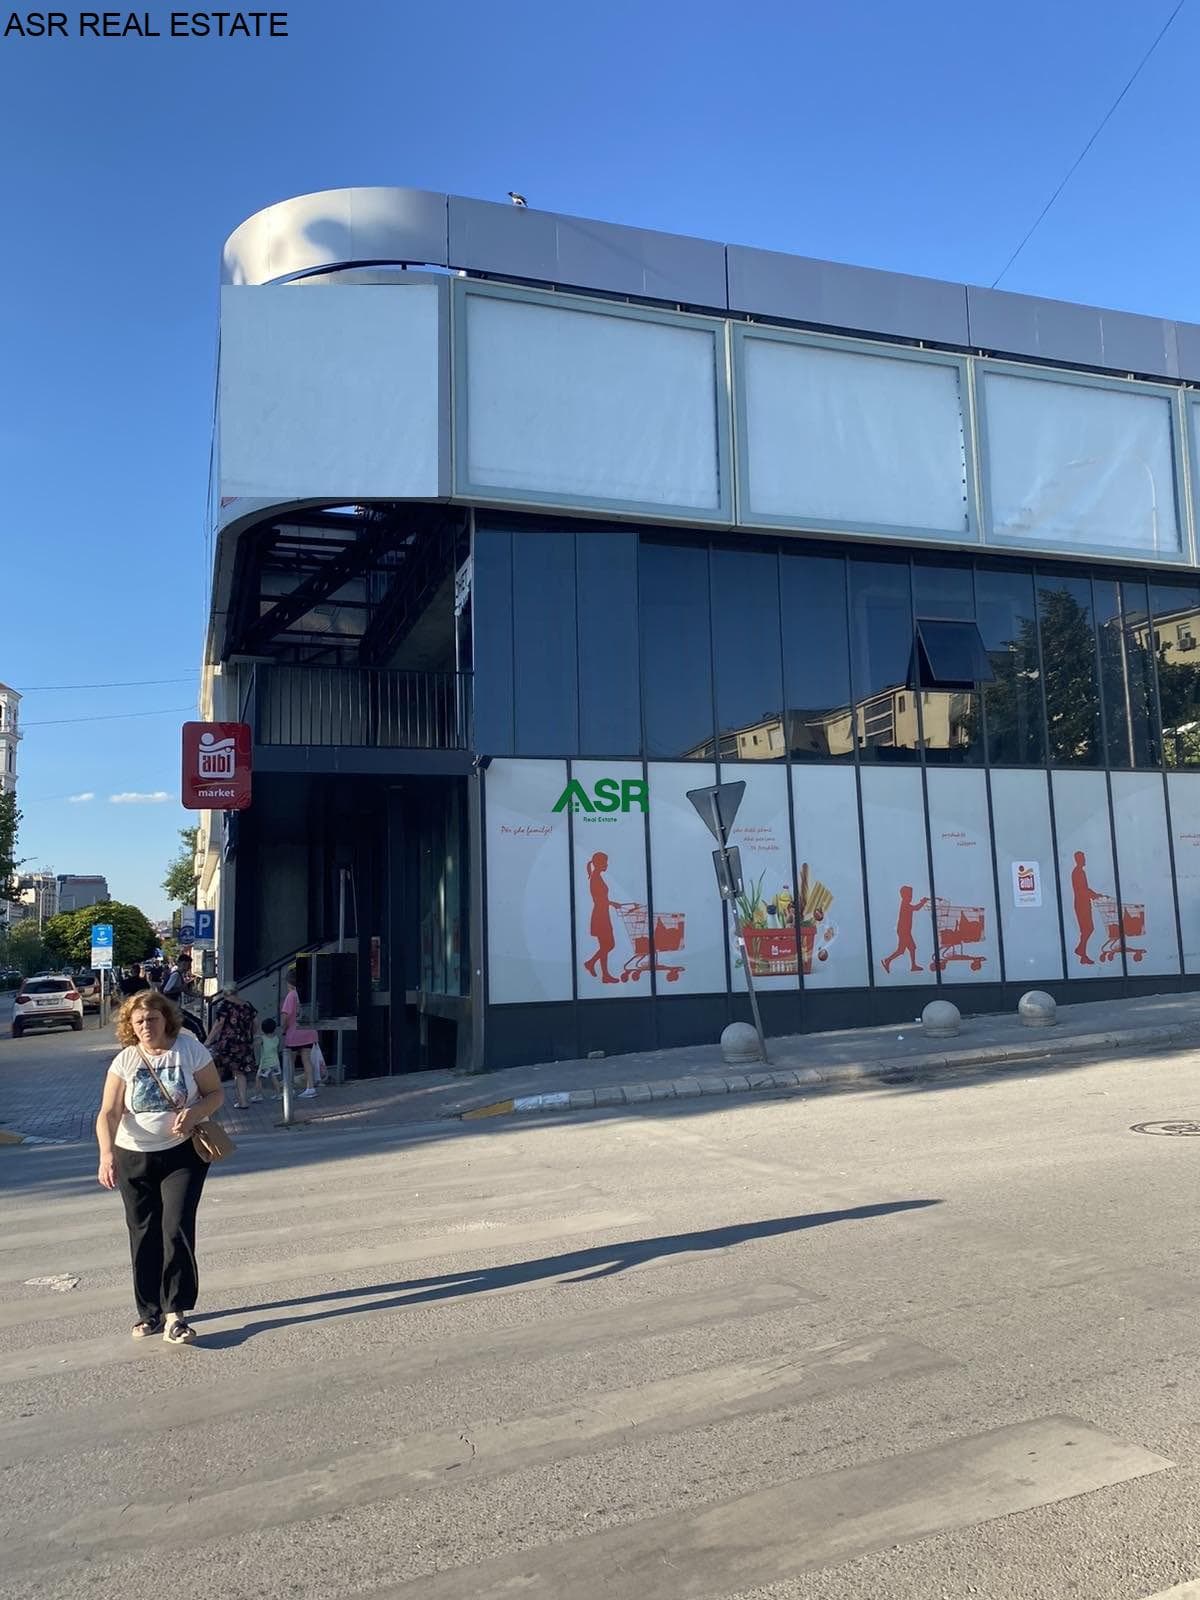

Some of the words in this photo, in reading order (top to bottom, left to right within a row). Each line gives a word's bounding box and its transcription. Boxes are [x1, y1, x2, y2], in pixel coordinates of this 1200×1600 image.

[202, 746, 231, 773] albi
[198, 788, 236, 798] market
[198, 913, 211, 936] P
